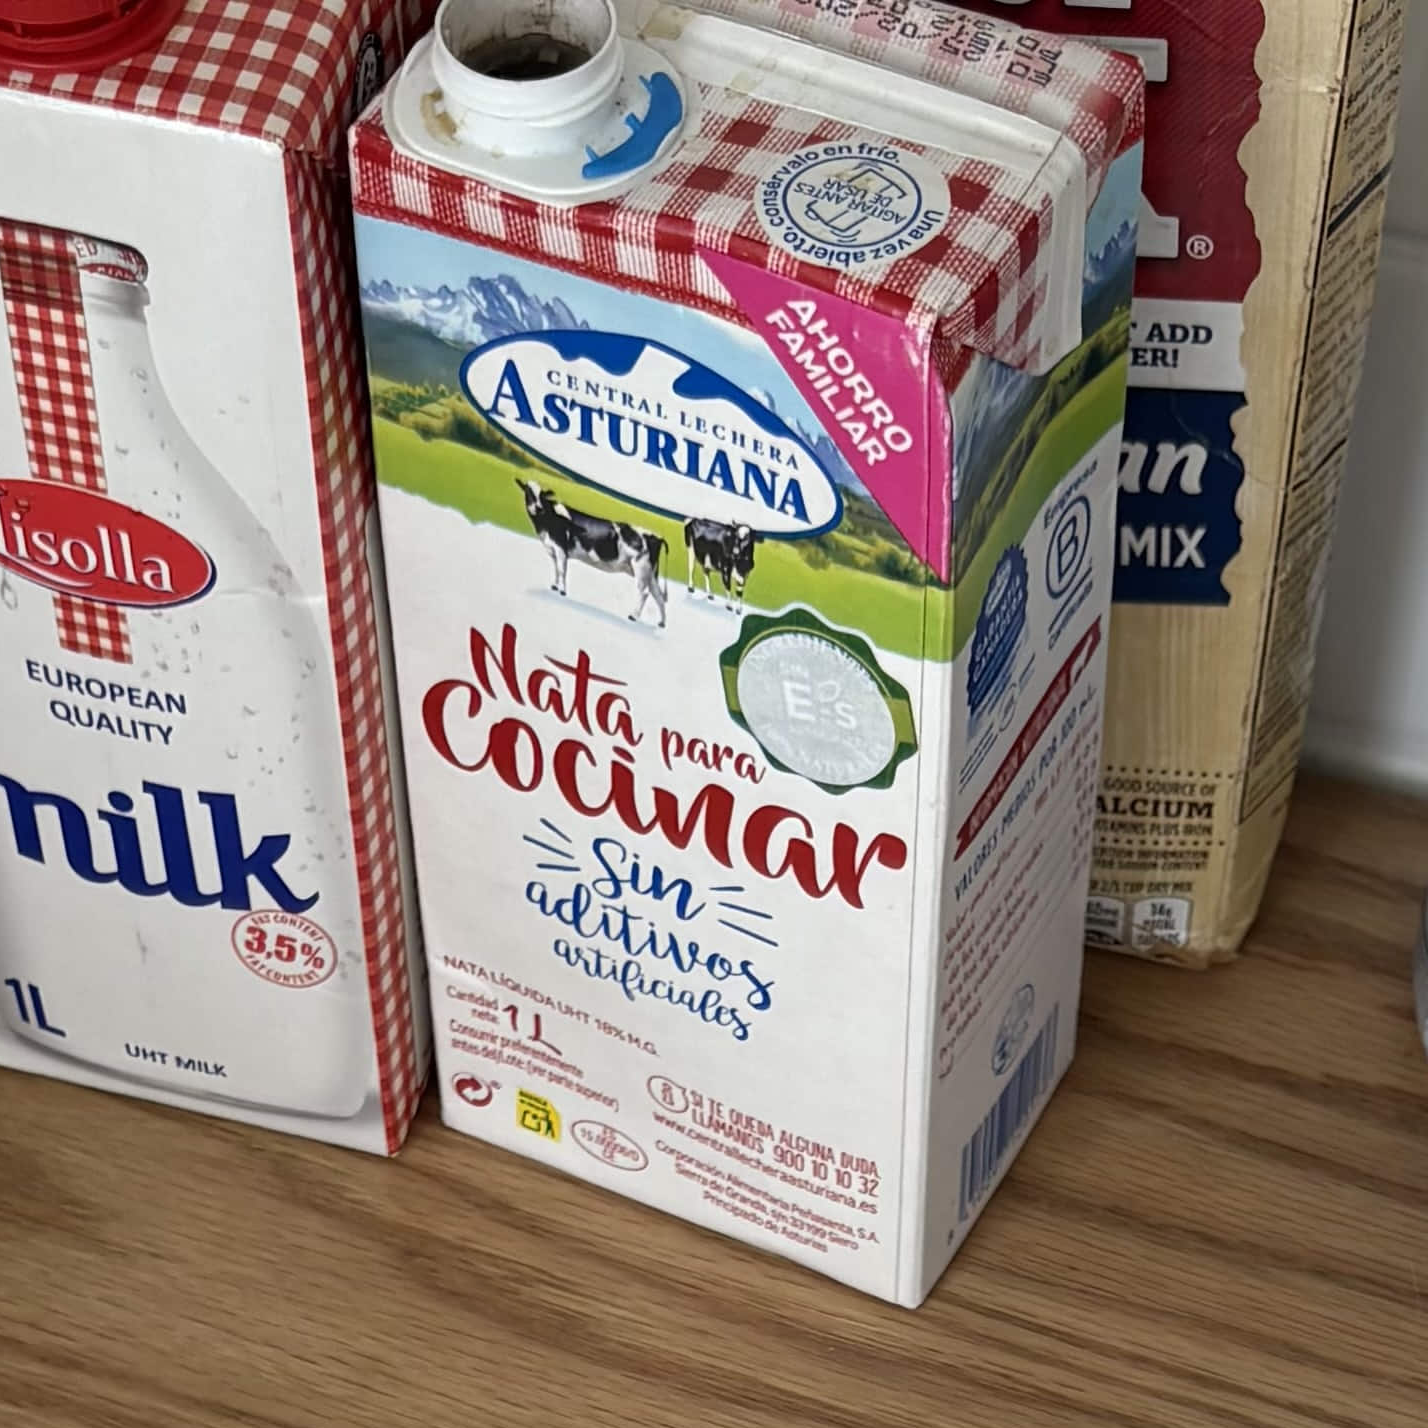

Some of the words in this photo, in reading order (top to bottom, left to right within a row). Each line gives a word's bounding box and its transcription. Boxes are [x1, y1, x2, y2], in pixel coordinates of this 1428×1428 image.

[822, 143, 852, 157] en
[761, 149, 820, 228] consérvalo
[793, 181, 848, 205] ANTES
[822, 177, 868, 199] USAR
[847, 197, 907, 225] AGITAR
[871, 192, 892, 208] DE
[783, 228, 868, 269] abierto,
[869, 234, 910, 261] vez
[908, 208, 943, 240] Una
[1145, 322, 1214, 346] ADD
[763, 308, 888, 469] FAMILIAR
[781, 295, 915, 457] AHORRO
[486, 357, 813, 528] ASTURIANA
[546, 369, 672, 421] CENTRAL
[679, 408, 802, 471] LECHERA
[1119, 525, 1208, 569] MIX
[25, 658, 188, 715] EUROPEAN
[470, 622, 644, 748] Nata
[660, 725, 768, 785] para
[49, 700, 174, 746] QUALITY
[421, 677, 909, 910] Cocinar
[1095, 795, 1216, 820] ALCIUM
[591, 836, 708, 922] Sin
[443, 955, 490, 982] NATA
[525, 879, 777, 1012] aditivos
[3, 976, 68, 1039] 1L
[553, 937, 752, 1043] artificiales
[124, 1042, 167, 1069] UHT
[174, 1054, 228, 1079] MILK
[707, 1097, 724, 1118] TE
[778, 1130, 837, 1165] ALGUNA
[773, 1144, 806, 1173] 900
[811, 1159, 829, 1181] 10
[835, 1168, 853, 1190] 10
[857, 1175, 881, 1198] 32
